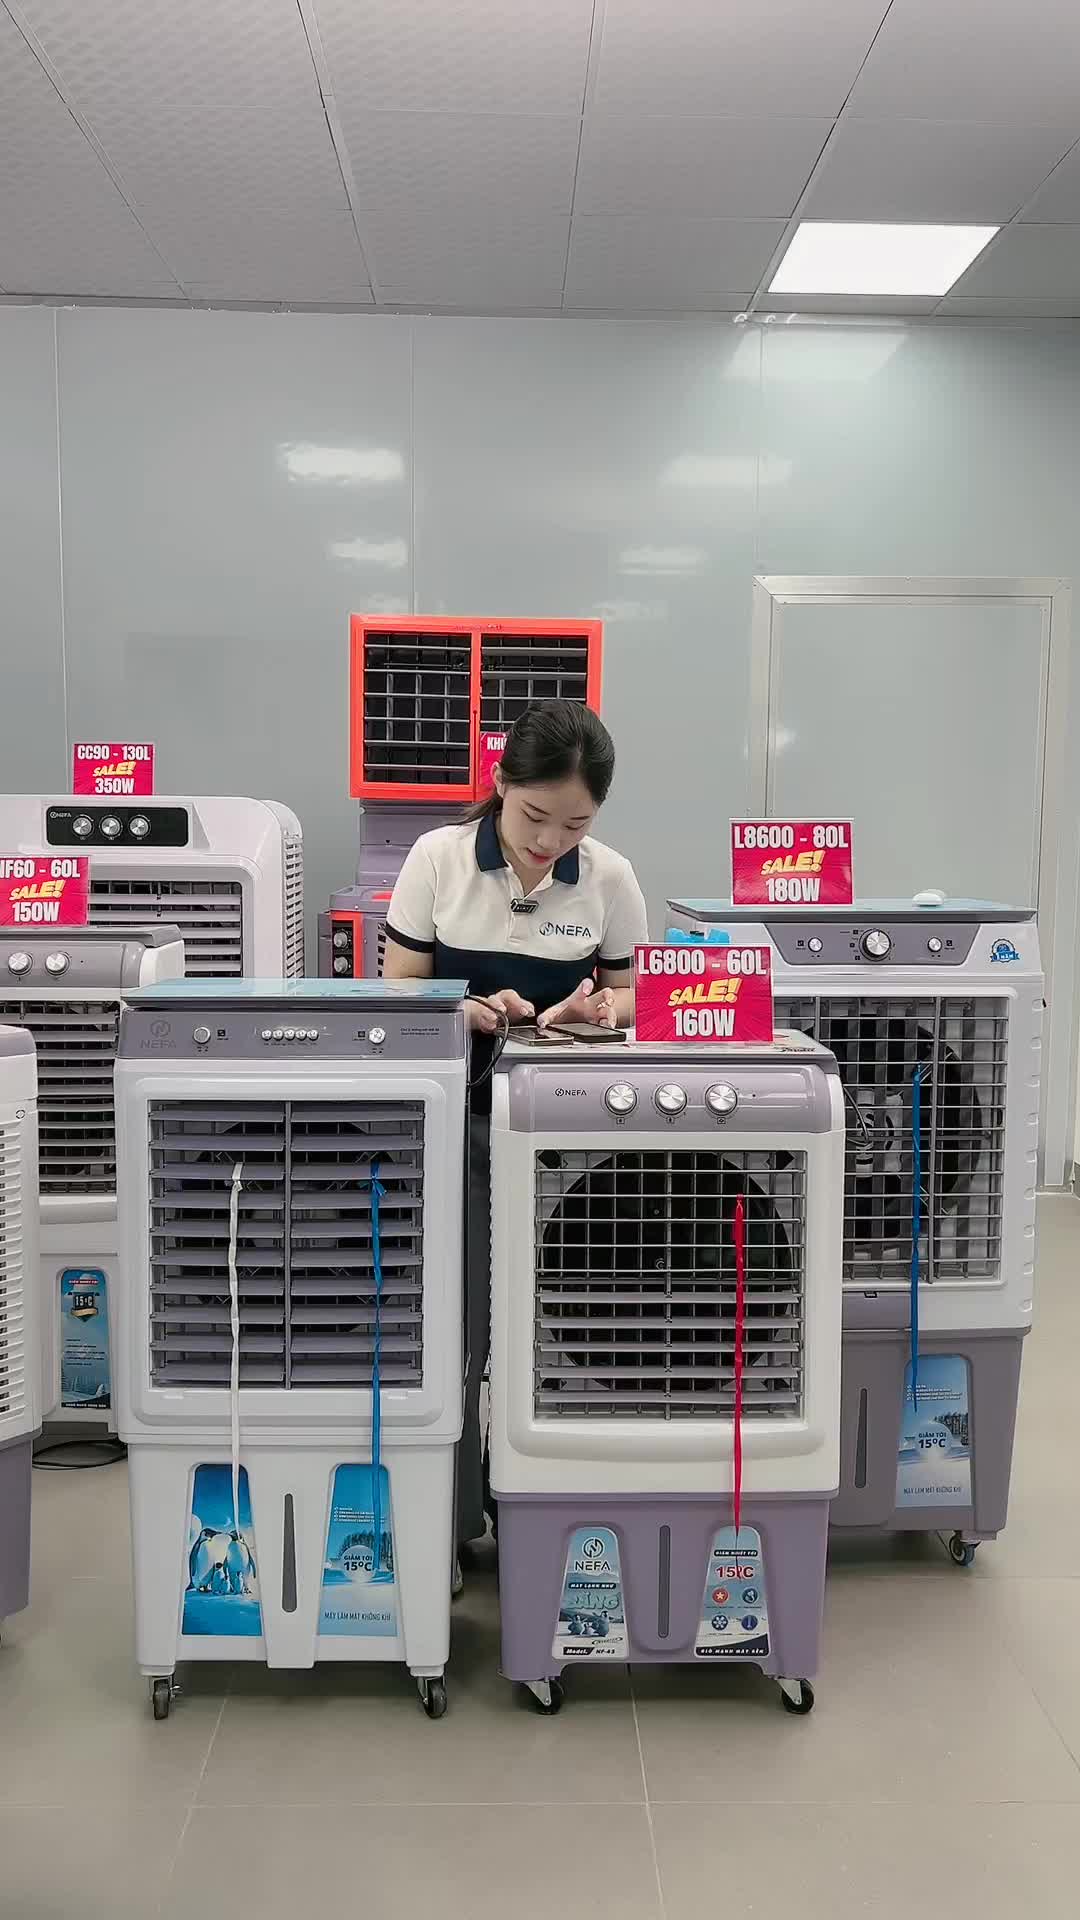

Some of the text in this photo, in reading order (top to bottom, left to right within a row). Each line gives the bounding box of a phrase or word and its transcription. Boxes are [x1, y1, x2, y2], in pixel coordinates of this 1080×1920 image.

[77, 745, 110, 761] CC90
[122, 745, 151, 761] 130L
[92, 761, 136, 777] SALE!
[95, 778, 134, 794] 350W
[734, 825, 794, 848] L8600
[813, 825, 849, 848] 80L
[50, 859, 81, 878] 60L
[760, 849, 826, 876] SALE!
[8, 879, 67, 901] SALE!
[765, 877, 821, 902] 180W
[12, 901, 61, 922] 150W
[555, 925, 592, 938] NEFA
[638, 949, 705, 975] L6800
[726, 949, 767, 975] 60L
[667, 977, 742, 1007] SALE!
[672, 1008, 736, 1037] 160W
[140, 1039, 177, 1049] NEFA
[575, 1560, 611, 1571] NEFA
